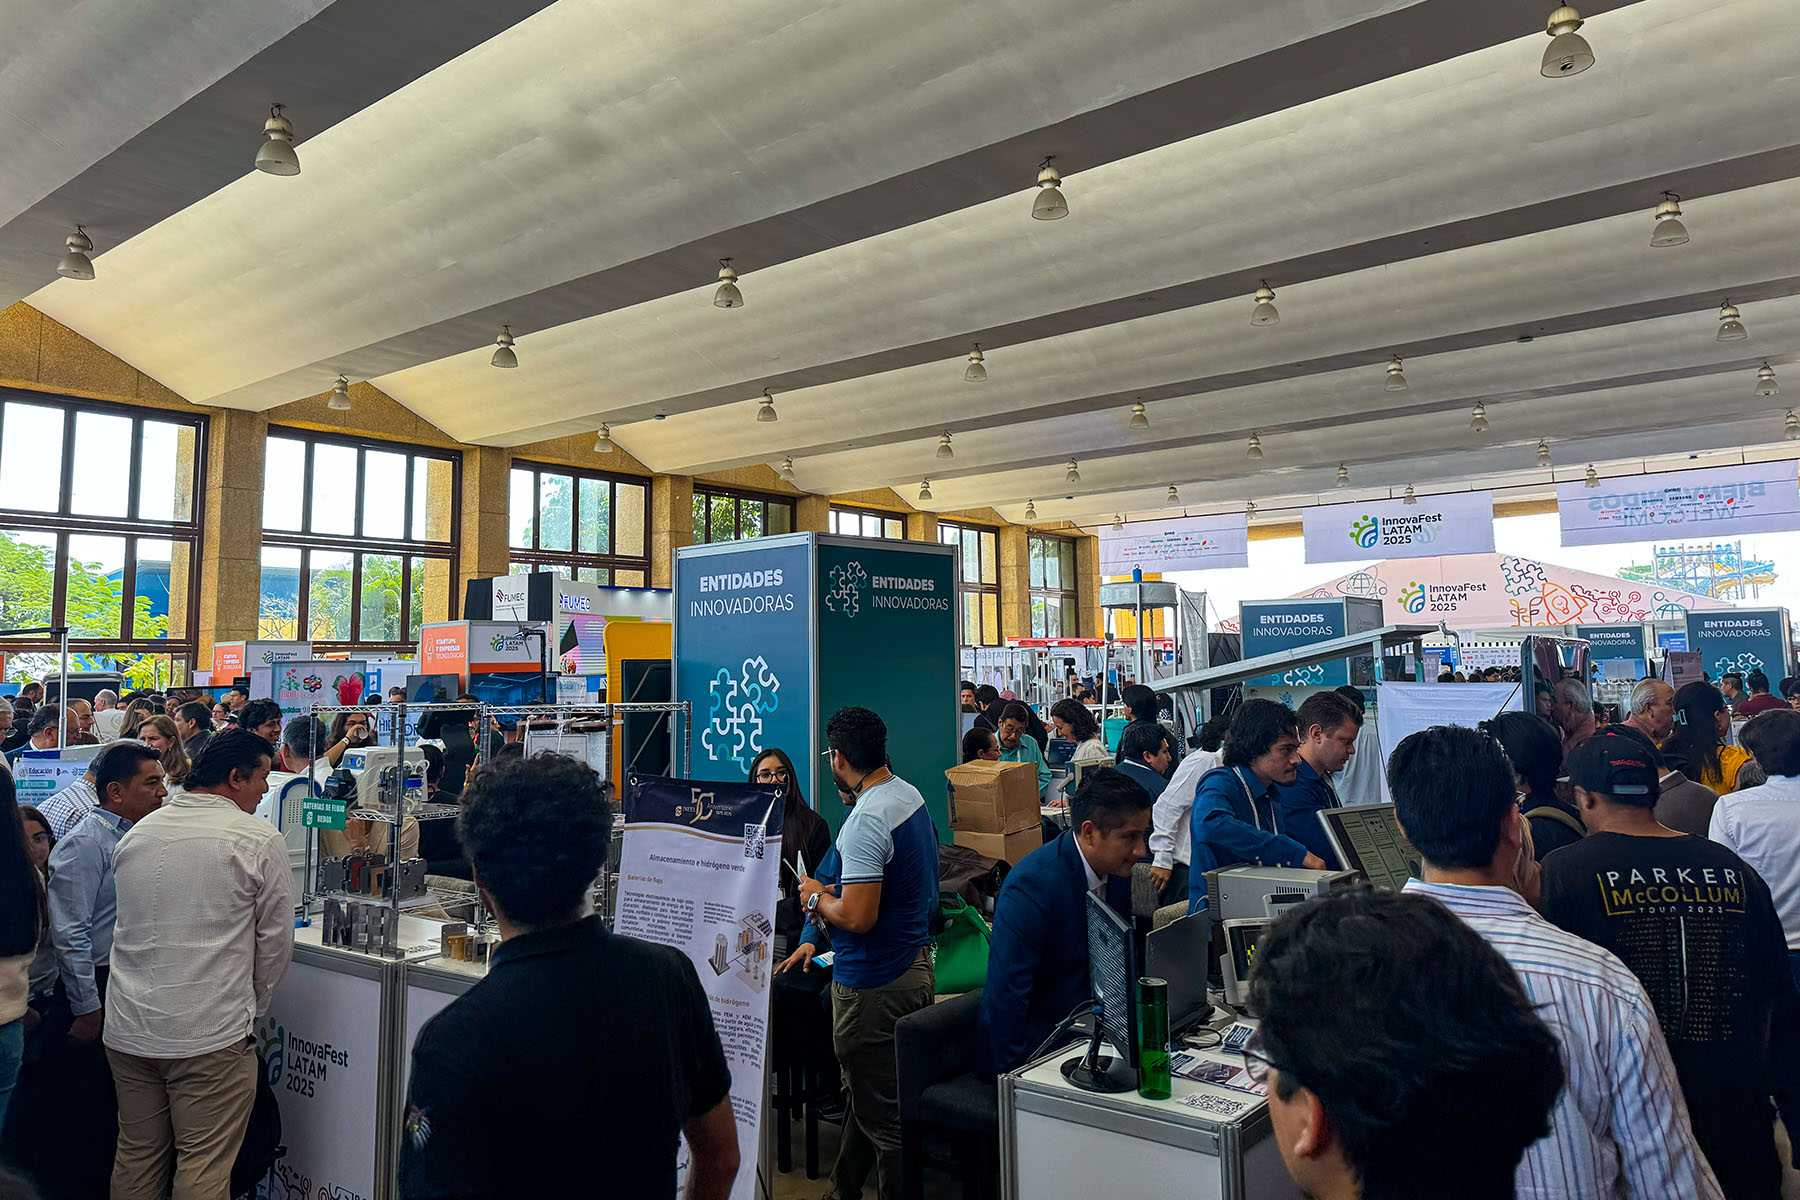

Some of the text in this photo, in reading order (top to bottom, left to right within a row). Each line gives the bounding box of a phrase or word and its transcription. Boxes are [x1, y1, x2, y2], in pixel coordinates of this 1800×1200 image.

[1382, 513, 1442, 526] InnovaFest
[1383, 525, 1422, 536] LATAM
[1384, 535, 1412, 545] 2025
[700, 568, 784, 592] ENTIDADES
[872, 576, 934, 592] ENTIDADES
[1430, 583, 1486, 592] InnovaFest
[504, 593, 524, 602] FUMEC
[563, 594, 590, 611] FUMEC
[872, 595, 948, 611] INNOVADORAS
[1430, 593, 1467, 602] LATAM
[690, 593, 794, 618] INNOVADORAS
[1430, 603, 1456, 612] 2025
[1260, 614, 1324, 624] ENTIDADES
[1704, 620, 1763, 628] ENTIDADES
[1253, 626, 1332, 636] INNOVADORAS
[1698, 629, 1771, 638] INNOVADORAS
[332, 804, 344, 812] FLUJO
[649, 854, 695, 866] Almacenamiento
[700, 860, 730, 870] hidrógeno
[731, 864, 745, 872] verde
[1606, 868, 1738, 887] PARKER
[1612, 886, 1740, 906] McCOLLUM
[721, 997, 750, 1007] hidrógeno
[288, 1032, 348, 1068] InnovaFest
[288, 1052, 327, 1082] LATAM
[286, 1074, 314, 1098] 2025
